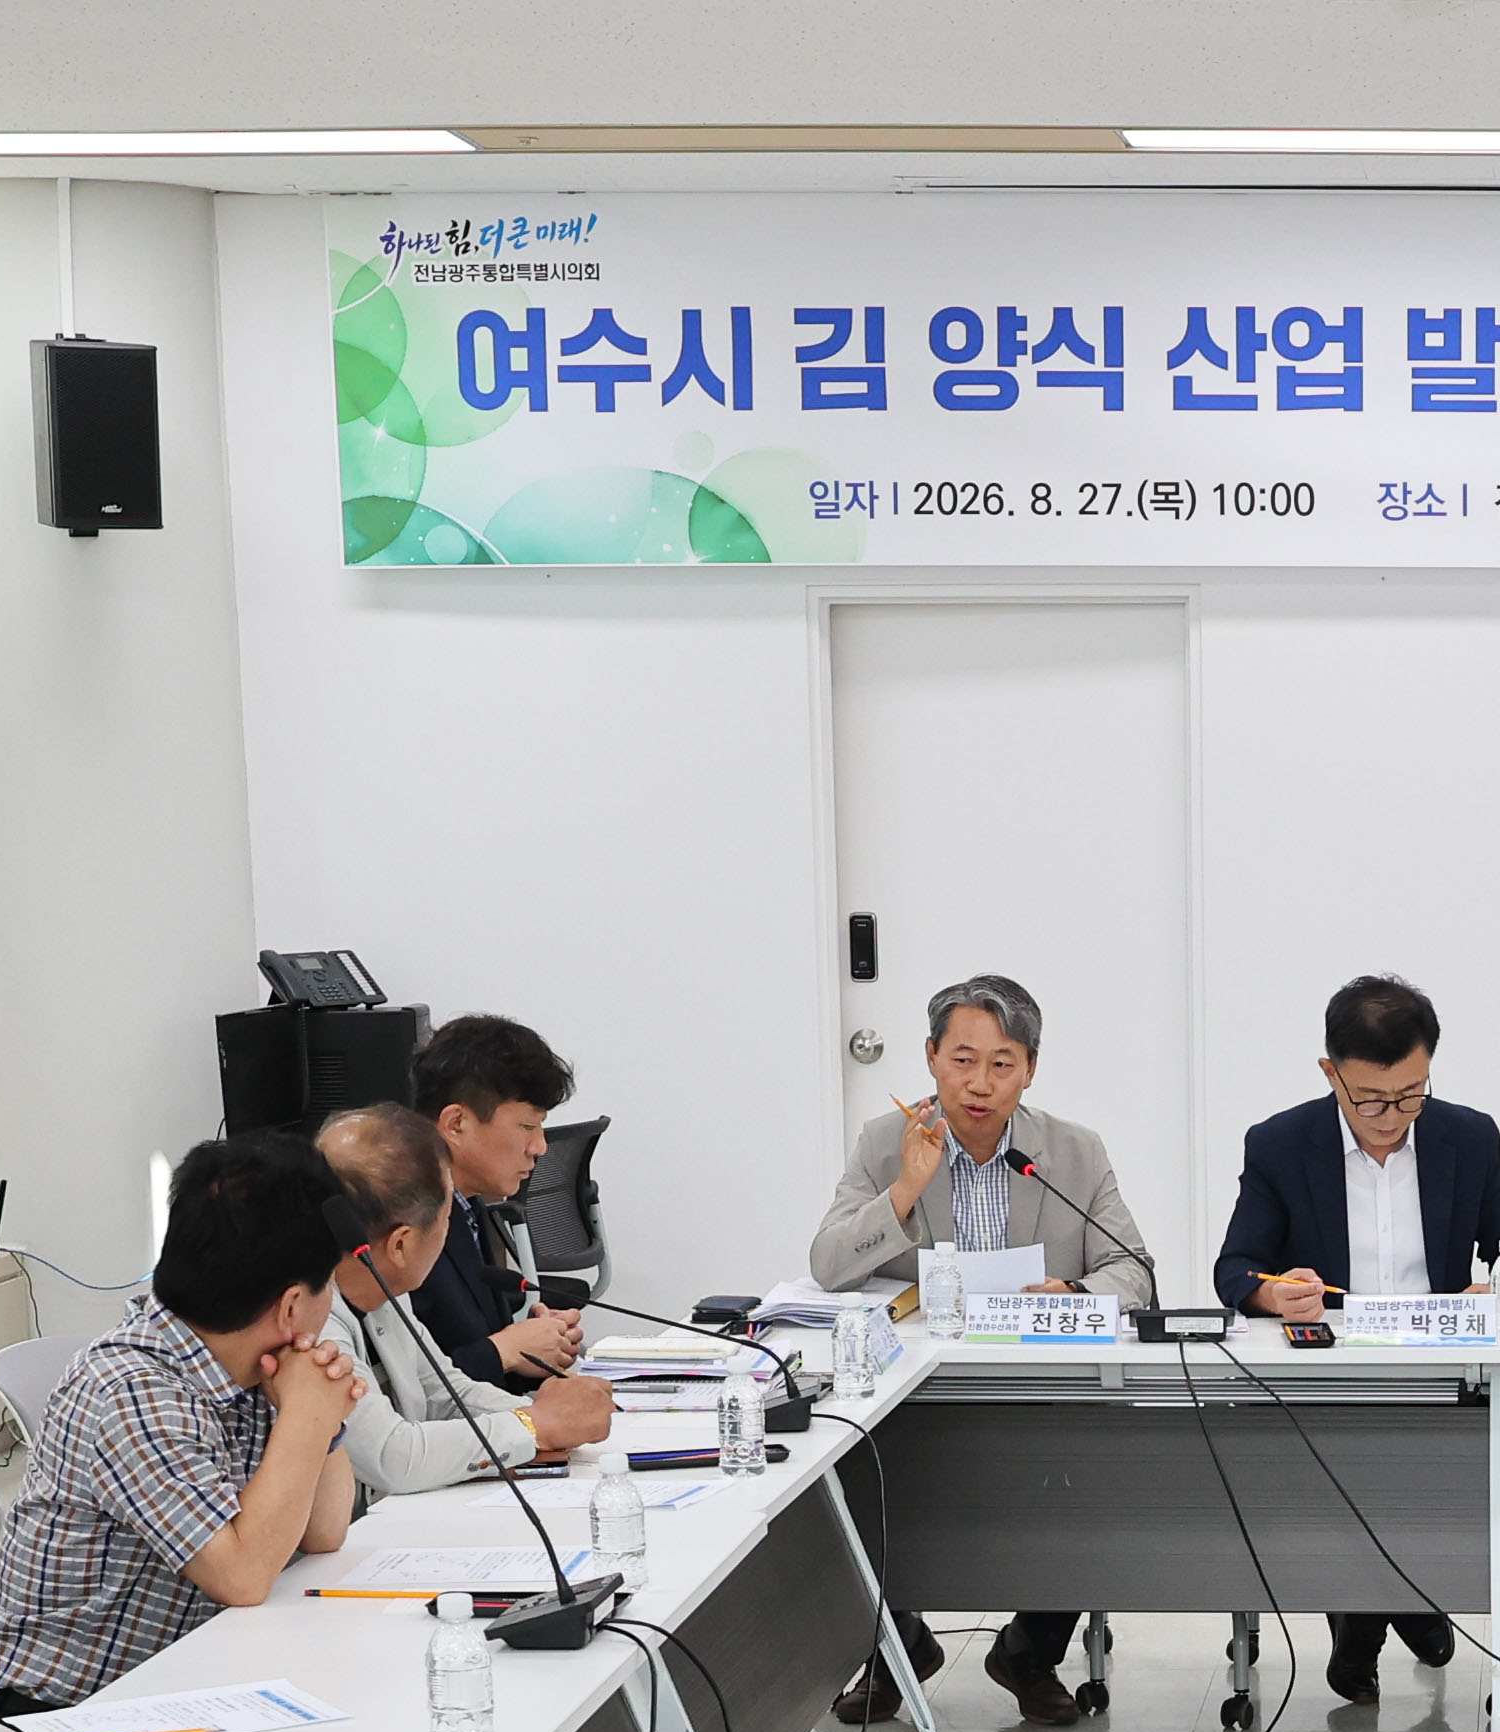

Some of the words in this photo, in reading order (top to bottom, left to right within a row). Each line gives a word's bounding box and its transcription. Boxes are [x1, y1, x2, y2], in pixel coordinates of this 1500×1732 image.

[380, 220, 442, 282] 하나된
[445, 218, 479, 257] 힘,
[479, 218, 504, 259] 더
[506, 216, 531, 250] 큰
[536, 213, 598, 245] 미래!
[413, 262, 601, 283] 전남광주통합특별시의회
[456, 306, 753, 413] 여수시
[793, 306, 888, 411] 김
[928, 306, 1124, 412] 양식
[1167, 306, 1364, 412] 산업
[809, 480, 880, 520] 일자
[913, 481, 1015, 517] 2026.
[1030, 482, 1062, 517] 8.
[1078, 479, 1197, 521] 27.(목)
[1212, 482, 1315, 517] 10:00
[1377, 481, 1447, 521] 장소
[987, 1297, 1097, 1309] 전남광주통합특별시
[1031, 1312, 1107, 1334] 전창우
